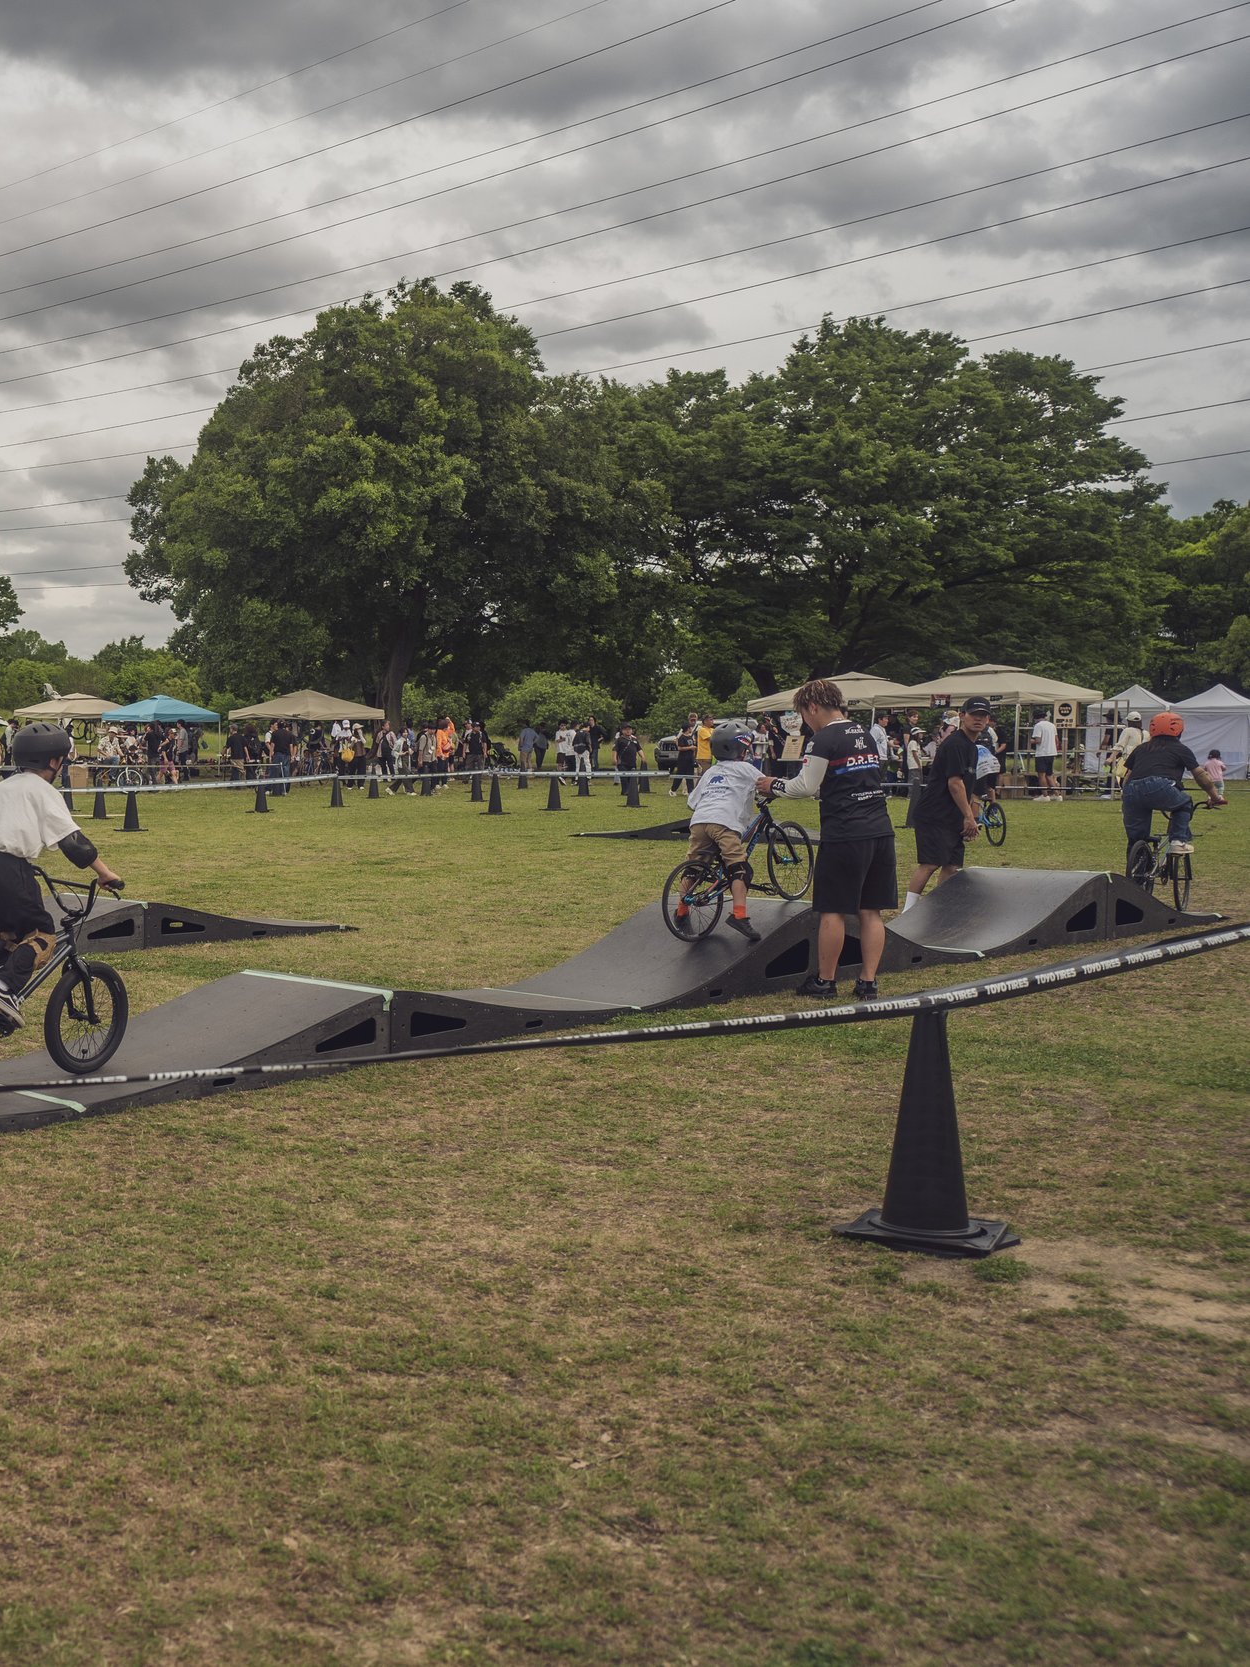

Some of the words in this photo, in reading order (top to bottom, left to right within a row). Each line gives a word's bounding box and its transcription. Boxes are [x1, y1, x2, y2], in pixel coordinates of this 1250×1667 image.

[1125, 953, 1145, 965] TOYO
[1144, 948, 1163, 961] TIRES
[1081, 963, 1102, 975] TOYO
[1101, 958, 1121, 971] TIRES
[1035, 973, 1056, 985] TOYO
[1055, 967, 1077, 981] TIRES
[951, 988, 978, 1001] TIRES
[984, 983, 1007, 995] TOYO
[1006, 977, 1029, 991] TIRES
[864, 1002, 892, 1012] TOYO
[891, 998, 921, 1009] TIRES
